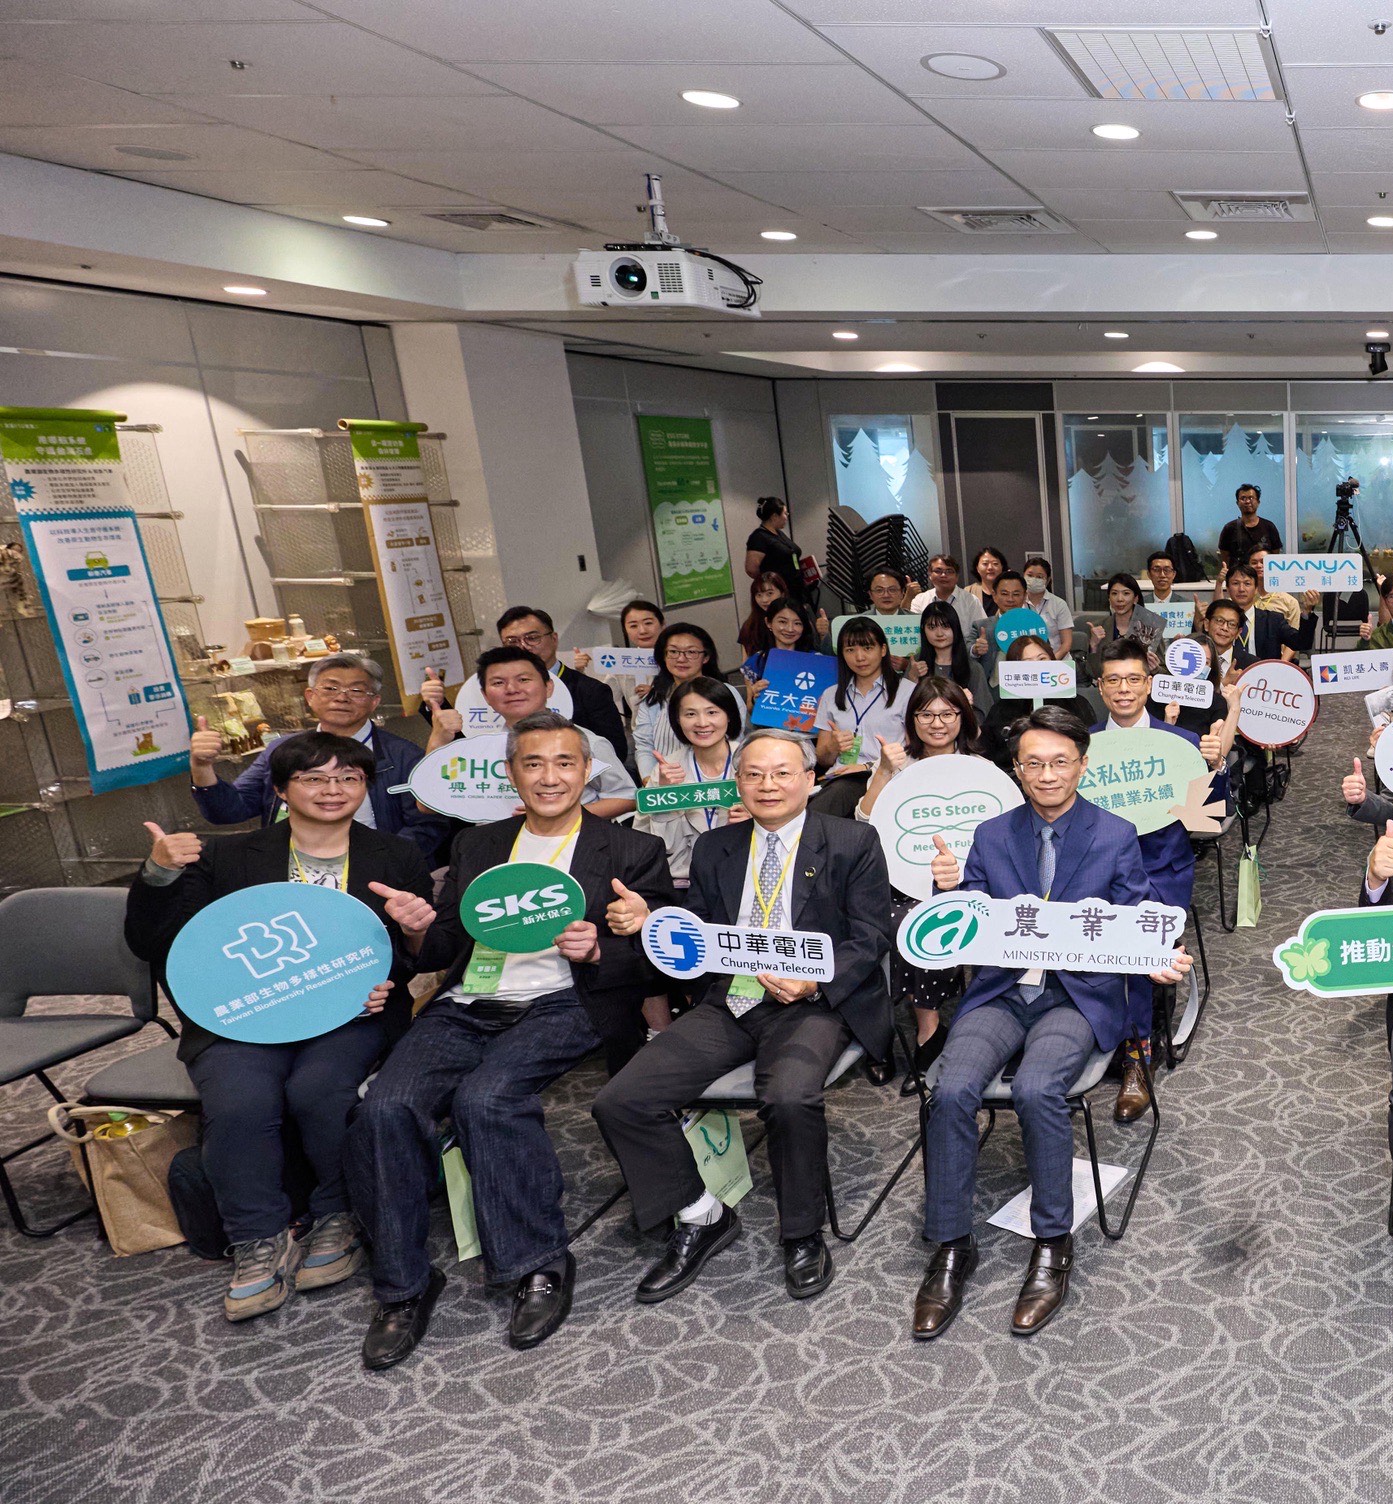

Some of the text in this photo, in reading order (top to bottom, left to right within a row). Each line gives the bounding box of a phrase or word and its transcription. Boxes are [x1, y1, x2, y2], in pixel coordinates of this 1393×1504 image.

[1269, 576, 1358, 587] 南亞科技
[1343, 662, 1389, 674] 凱基人壽
[1004, 672, 1070, 687] 中華電信 ESG
[1159, 680, 1206, 695] 中華電信
[1158, 692, 1205, 703] Chunghwa Telecom
[1274, 690, 1303, 709] TCC
[1265, 711, 1306, 727] HOLDINGS
[646, 791, 678, 807] SKS
[693, 788, 721, 802] 永續
[912, 804, 986, 819] ESG Store
[913, 843, 935, 852] Mee
[475, 884, 569, 923] SKS
[522, 907, 573, 925] 新光保全
[1004, 903, 1178, 946] 農業部
[717, 931, 824, 960] 中華電信
[720, 956, 825, 975] Chunghwa Telecom
[1002, 949, 1176, 967] MINISTRY OF AGRICULTURE
[213, 945, 375, 1018] 農業部生物多樣性研究所
[221, 958, 381, 1026] Taiwan Biodiversity Research Institute
